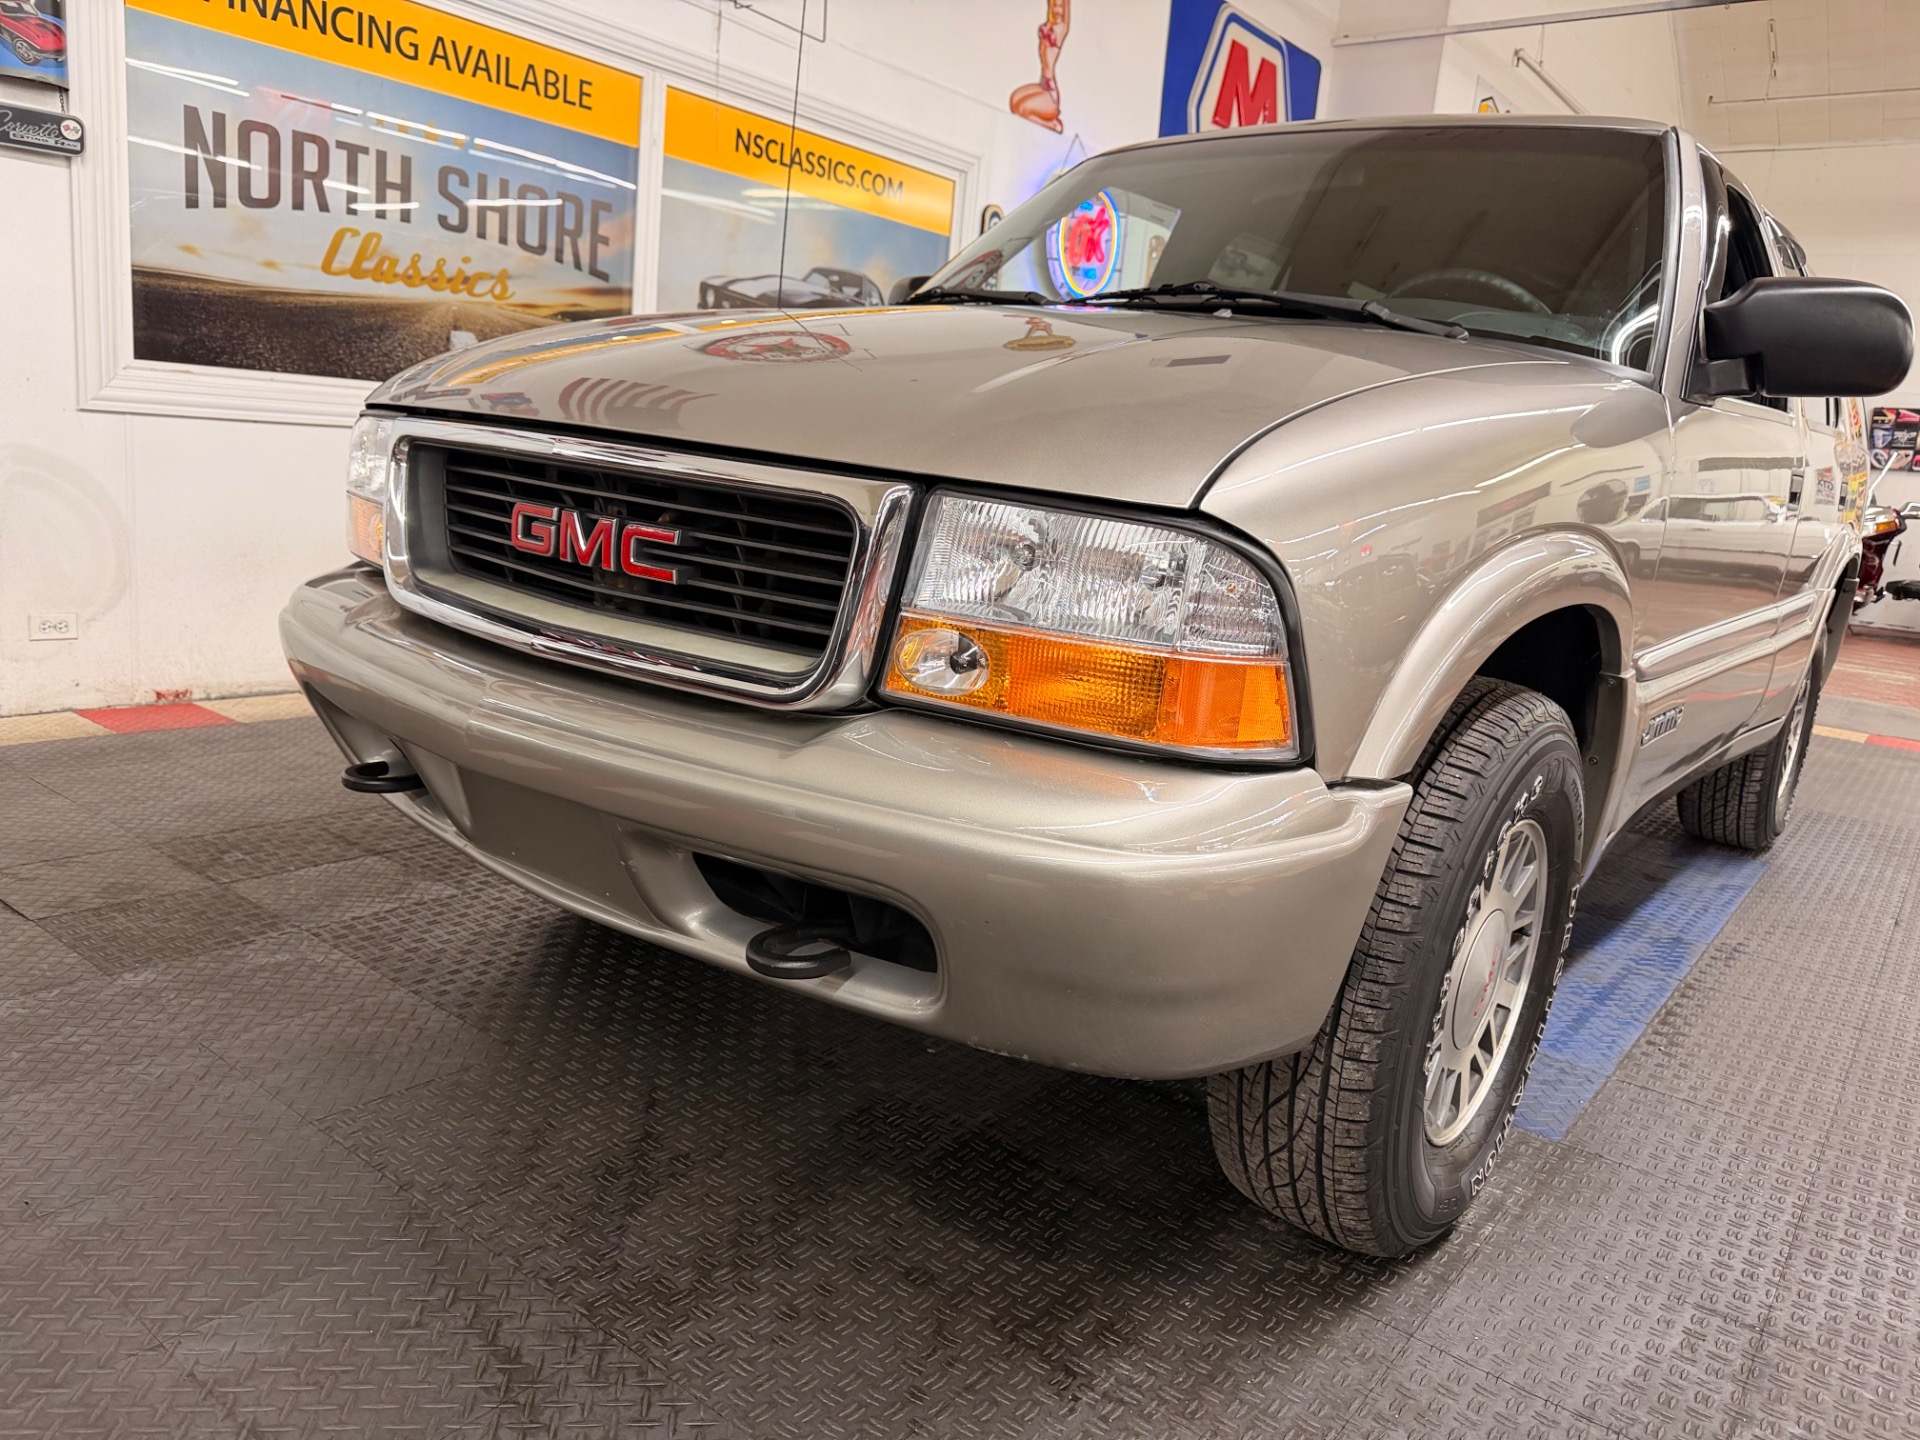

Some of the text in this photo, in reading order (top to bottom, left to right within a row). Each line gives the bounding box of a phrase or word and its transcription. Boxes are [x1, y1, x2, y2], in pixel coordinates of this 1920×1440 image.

[203, 0, 593, 111] ANCING AVAILABLE
[1212, 39, 1277, 128] M
[183, 104, 613, 284] NORTH SHORE
[735, 127, 904, 201] NSCLASSICS.COM
[321, 226, 516, 301] Classics
[510, 501, 682, 585] GMC
